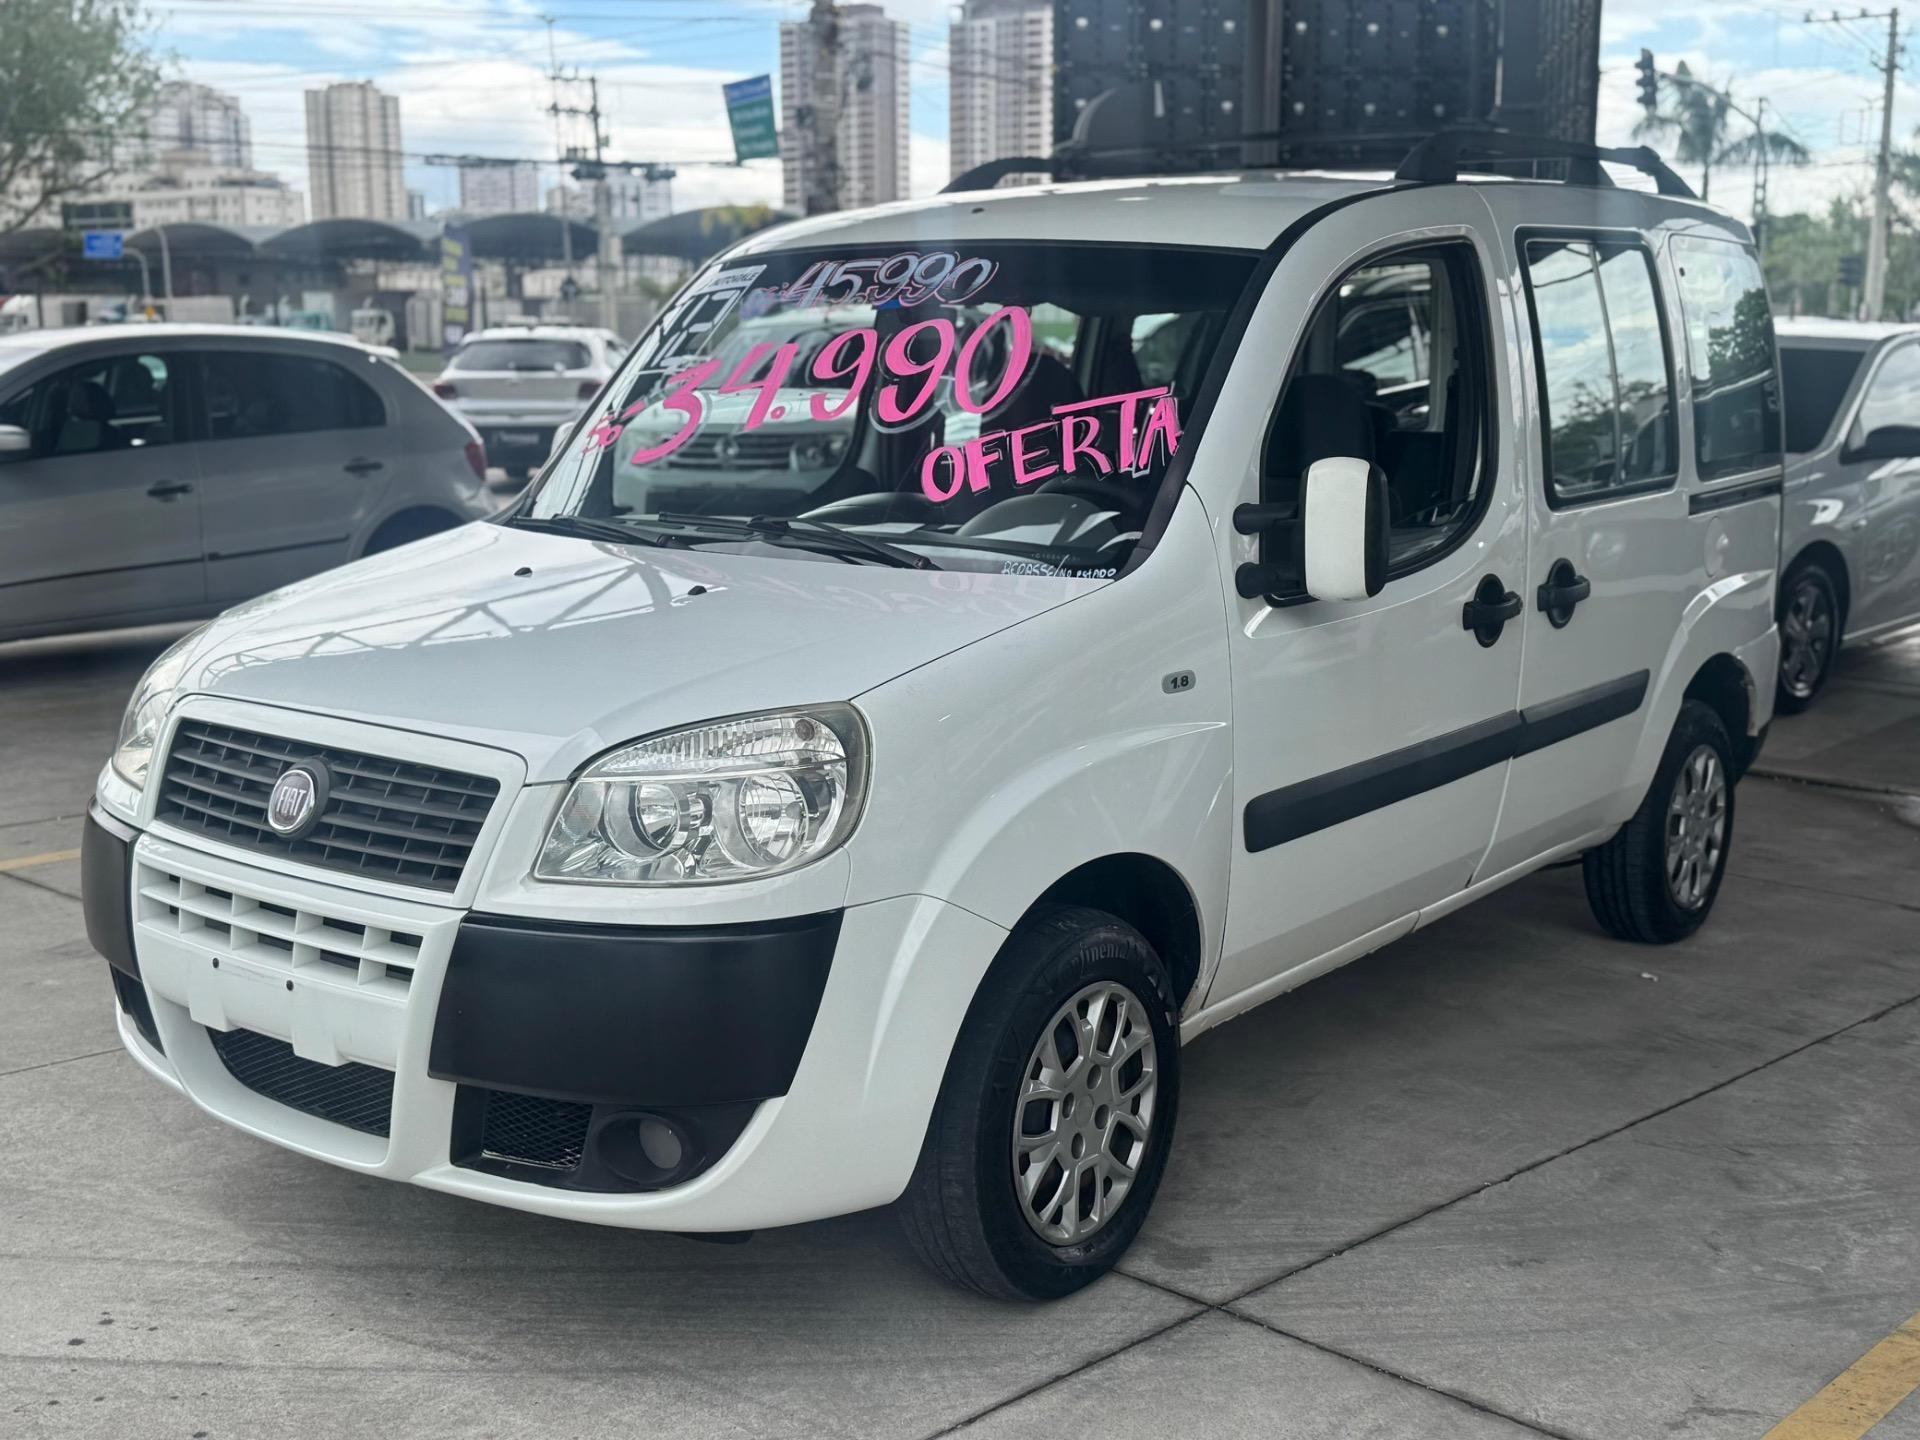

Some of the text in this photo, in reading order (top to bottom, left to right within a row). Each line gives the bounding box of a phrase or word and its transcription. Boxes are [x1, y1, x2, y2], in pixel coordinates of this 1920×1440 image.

[630, 305, 1033, 465] 34.990
[921, 386, 1184, 503] OFERTA
[1170, 675, 1189, 690] 1.8
[276, 786, 307, 816] FIAT
